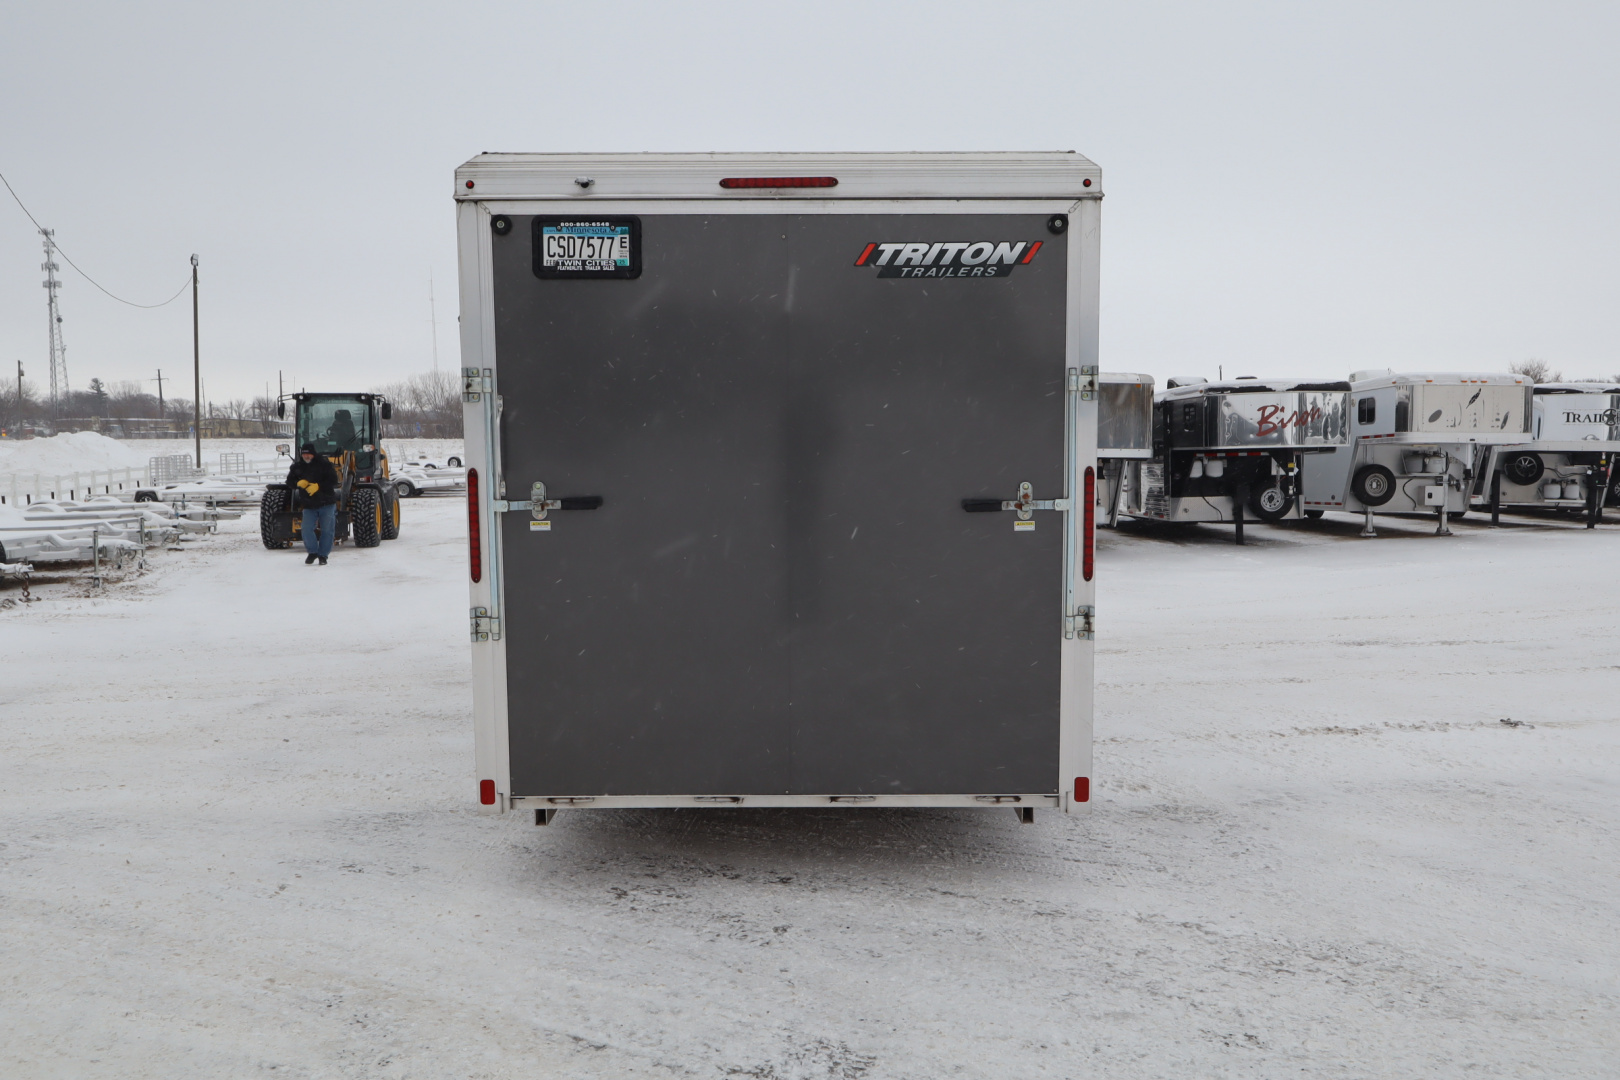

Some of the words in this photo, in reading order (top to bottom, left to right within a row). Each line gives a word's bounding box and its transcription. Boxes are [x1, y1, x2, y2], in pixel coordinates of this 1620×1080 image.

[548, 236, 614, 258] CSD7577
[620, 237, 627, 248] E
[875, 241, 1027, 266] TRITON
[901, 267, 997, 277] TRAILERS
[1256, 404, 1321, 437] Bison
